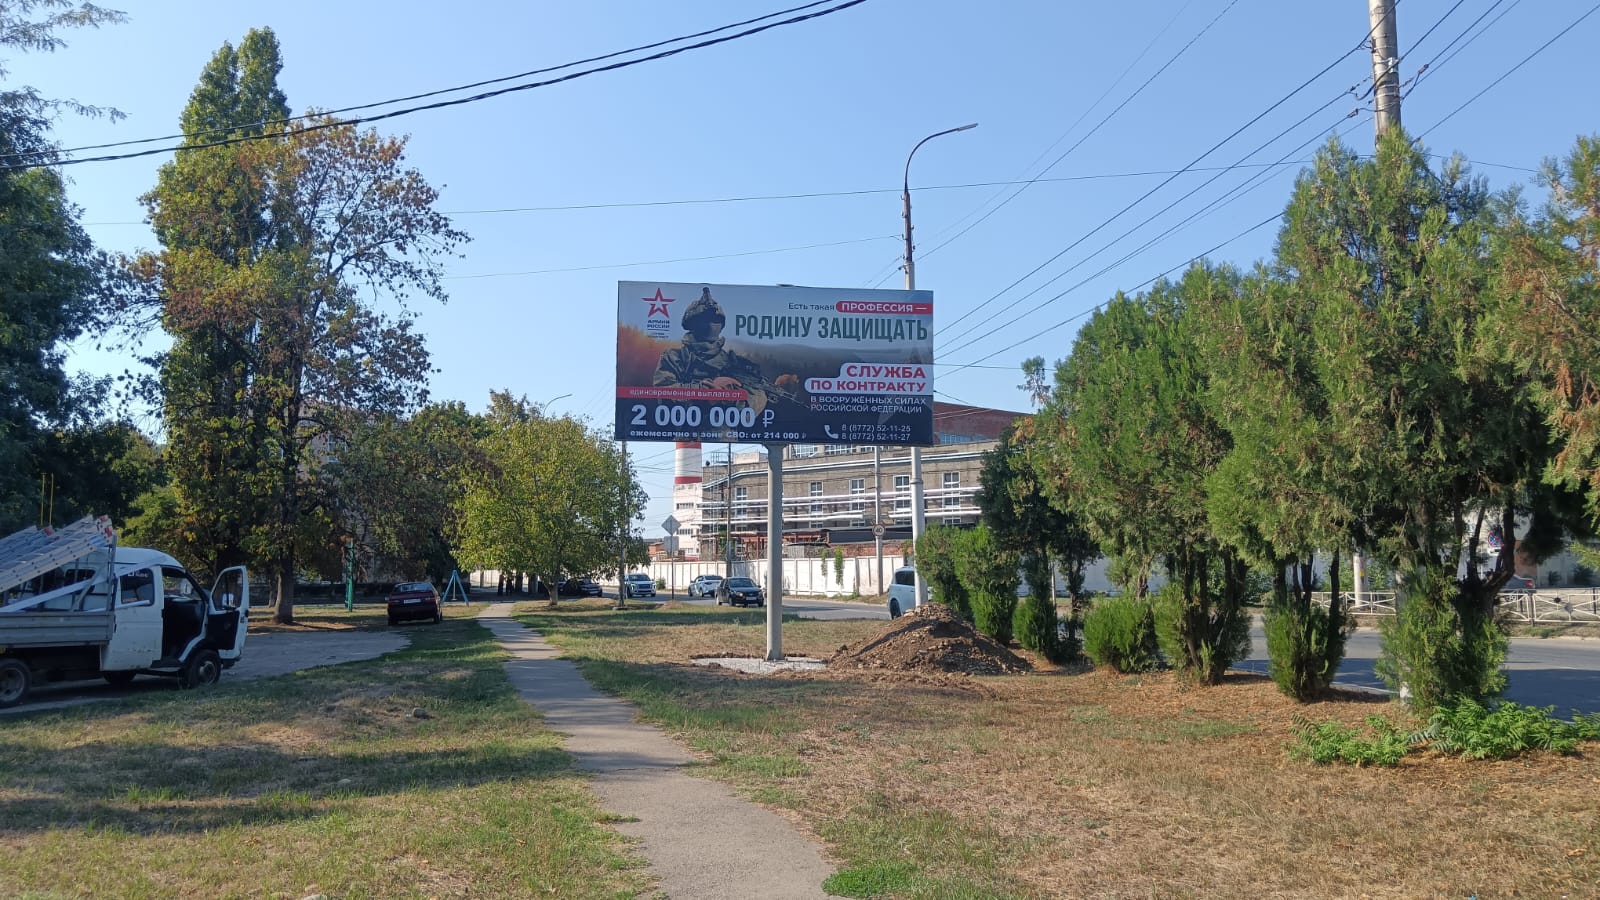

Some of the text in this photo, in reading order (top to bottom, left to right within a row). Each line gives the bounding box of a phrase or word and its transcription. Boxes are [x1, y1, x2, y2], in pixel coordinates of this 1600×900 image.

[842, 303, 913, 312] ПРОФЕССИЯ
[735, 315, 928, 342] РОДИНУ ЗАЩИЩАТЬ
[846, 365, 926, 379] СЛУЖБА
[810, 380, 926, 392] ПО КОНТРАКТУ
[894, 397, 926, 405] СИЛАХ
[810, 403, 922, 414] РОССИЙСКОЙ ФЕДЕРАЦИИ
[631, 404, 647, 425] 2
[655, 405, 702, 427] 000
[709, 406, 756, 428] 000
[849, 424, 875, 432] (8772)
[876, 424, 911, 432] 52-11-25
[726, 431, 749, 439] СВО:
[841, 432, 911, 441] 8 (8772) 52-11-27
